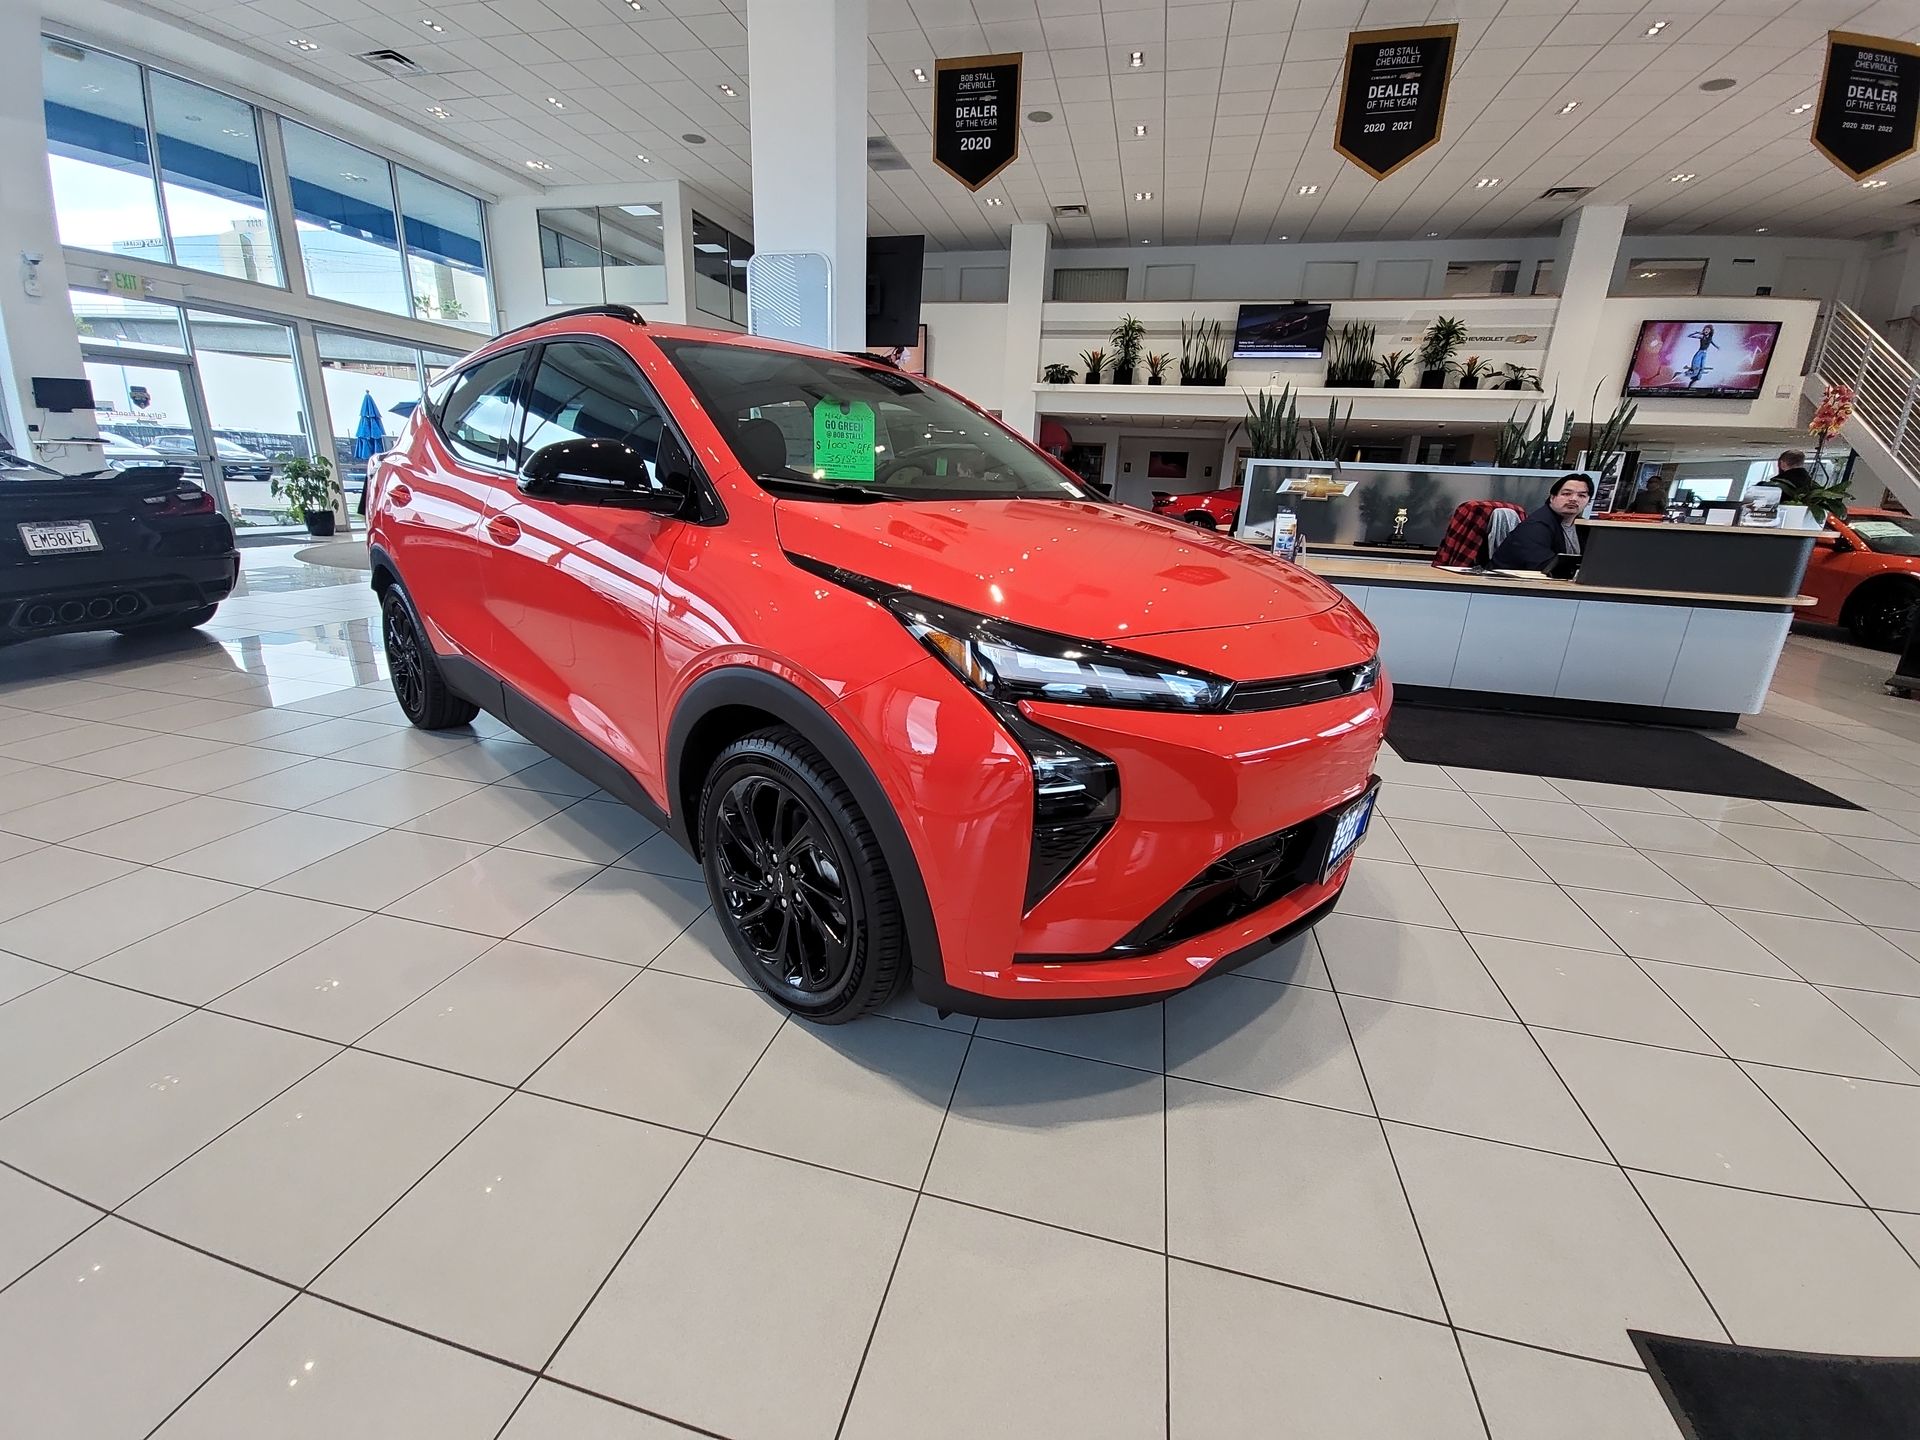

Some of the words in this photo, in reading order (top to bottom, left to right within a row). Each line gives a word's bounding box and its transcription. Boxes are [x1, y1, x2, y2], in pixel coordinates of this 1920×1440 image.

[1379, 48, 1395, 57] BOB
[1396, 46, 1420, 56] STALL
[1858, 51, 1873, 61] BOB
[1874, 54, 1897, 65] STALL
[1376, 54, 1422, 66] CHEVROLET
[1855, 60, 1898, 73] CHEVROLET
[960, 74, 974, 82] BOB
[974, 72, 995, 81] STALL
[958, 80, 996, 90] CHEVROLET
[1368, 82, 1420, 99] DEALER
[1848, 85, 1898, 103] DEALER
[1366, 100, 1378, 110] OF
[1379, 99, 1395, 109] THE
[1397, 97, 1418, 108] YEAR
[1845, 100, 1857, 108] OF
[1859, 101, 1874, 110] THE
[1876, 102, 1897, 113] YEAR
[956, 105, 998, 119] DEALER
[955, 119, 965, 128] OF
[966, 119, 979, 127] THE
[980, 117, 998, 127] YEAR
[1364, 122, 1386, 133] 2020
[1392, 121, 1413, 131] 2021
[1842, 121, 1858, 129] 2020
[1860, 123, 1875, 131] 2021
[1878, 124, 1893, 133] 2022
[960, 137, 991, 151] 2020
[115, 272, 137, 290] EXIT
[825, 420, 836, 430] GO
[30, 530, 91, 549] EM58V54
[1333, 810, 1358, 843] BOB
[1328, 821, 1359, 864] STALL
